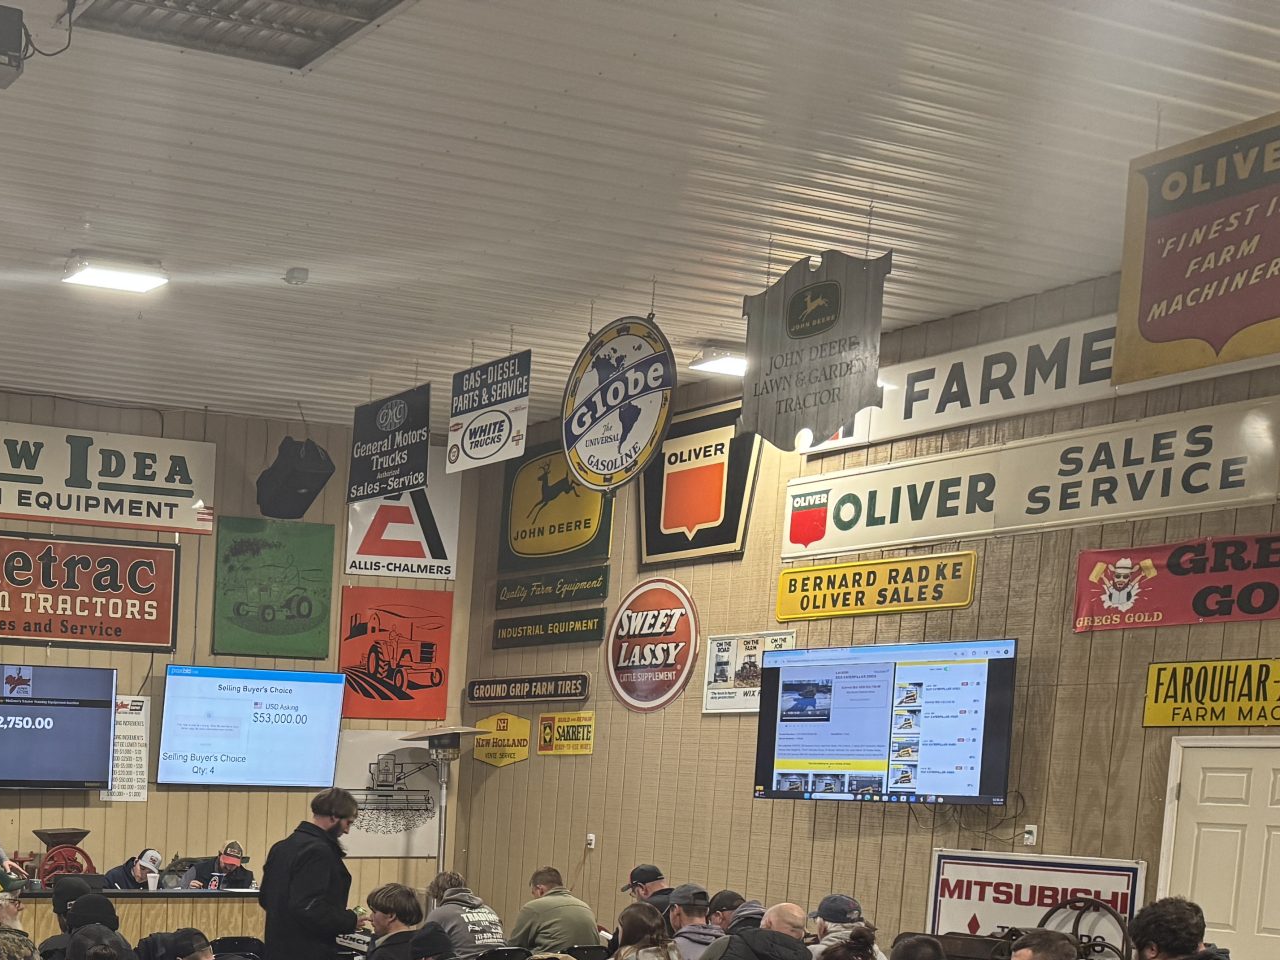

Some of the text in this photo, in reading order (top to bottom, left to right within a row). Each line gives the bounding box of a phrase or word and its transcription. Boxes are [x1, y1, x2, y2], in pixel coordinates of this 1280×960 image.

[1161, 139, 1280, 201] OLIVE
[1185, 234, 1261, 278] FARM
[1147, 257, 1280, 322] MACHINER
[766, 335, 860, 376] JOHN DEERE
[463, 357, 520, 391] GAS-DIESEL
[753, 356, 869, 397] LAWN GARDEN
[902, 326, 1117, 421] FARME
[452, 376, 528, 414] PARTS SERVICE
[571, 361, 664, 435] Globe
[775, 387, 841, 415] TRACTOR
[354, 426, 428, 459] General Motors
[469, 420, 506, 441] WHITE
[469, 434, 502, 451] TRUCKS
[585, 432, 620, 448] UNIVERSAL
[370, 450, 408, 471] Trucks
[587, 441, 641, 472] GASOLINE
[667, 442, 725, 466] OLIVER
[1058, 424, 1214, 478] SALES
[17, 489, 179, 519] EQUIPMENT
[793, 456, 1248, 531] OLIVER OLIVER SERVICE
[514, 518, 592, 541] JOHN DEERE
[349, 560, 452, 575] ALLIS-CHALMERS
[788, 561, 963, 594] BERNARD RADKE
[556, 575, 603, 598] Equipment
[799, 583, 945, 611] OLIVER SALES
[21, 591, 157, 620] TRACTORS
[23, 618, 53, 633] and
[59, 619, 123, 637] Service
[498, 618, 599, 639] INDUSTRIAL EQUIPMENT
[618, 608, 686, 637] SWEET
[1075, 611, 1163, 628] GREG'S GOLD
[617, 642, 686, 668] LASSY
[473, 679, 582, 698] GROUND GRIP FARM TIRES
[637, 671, 676, 682] SUPPLEMENT
[217, 684, 293, 695] Selling Buyer's Choice
[252, 712, 308, 725] $53,000.00
[279, 704, 299, 712] Asking
[1171, 706, 1226, 722] FARM
[492, 737, 528, 748] HOLLAND
[555, 724, 592, 741] SAKRETE
[162, 752, 246, 764] Selling Buyer's Choice
[192, 766, 208, 775] Qty:
[939, 878, 1129, 915] MITSUBISHI
